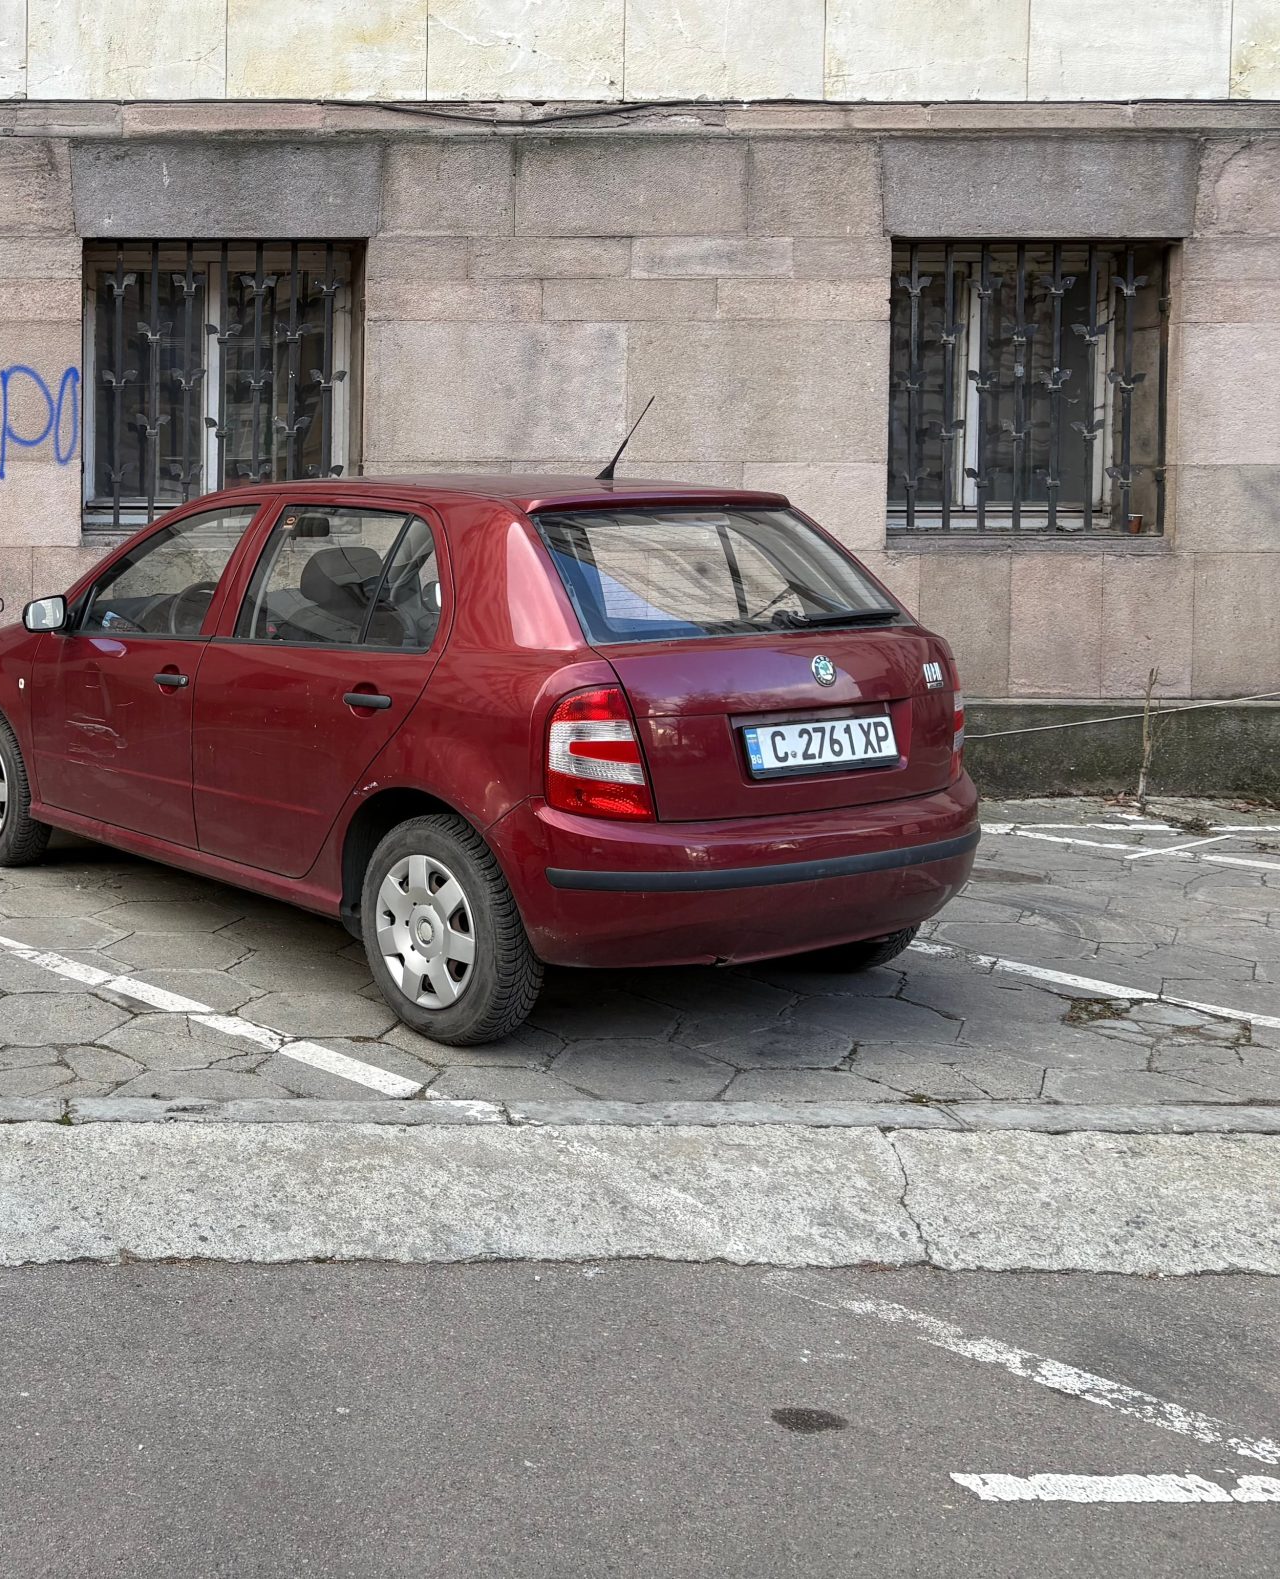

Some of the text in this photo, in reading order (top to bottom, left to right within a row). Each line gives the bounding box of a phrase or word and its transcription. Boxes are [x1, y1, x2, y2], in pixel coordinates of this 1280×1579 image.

[770, 721, 889, 763] C 2761 XP
[751, 754, 762, 764] BG
